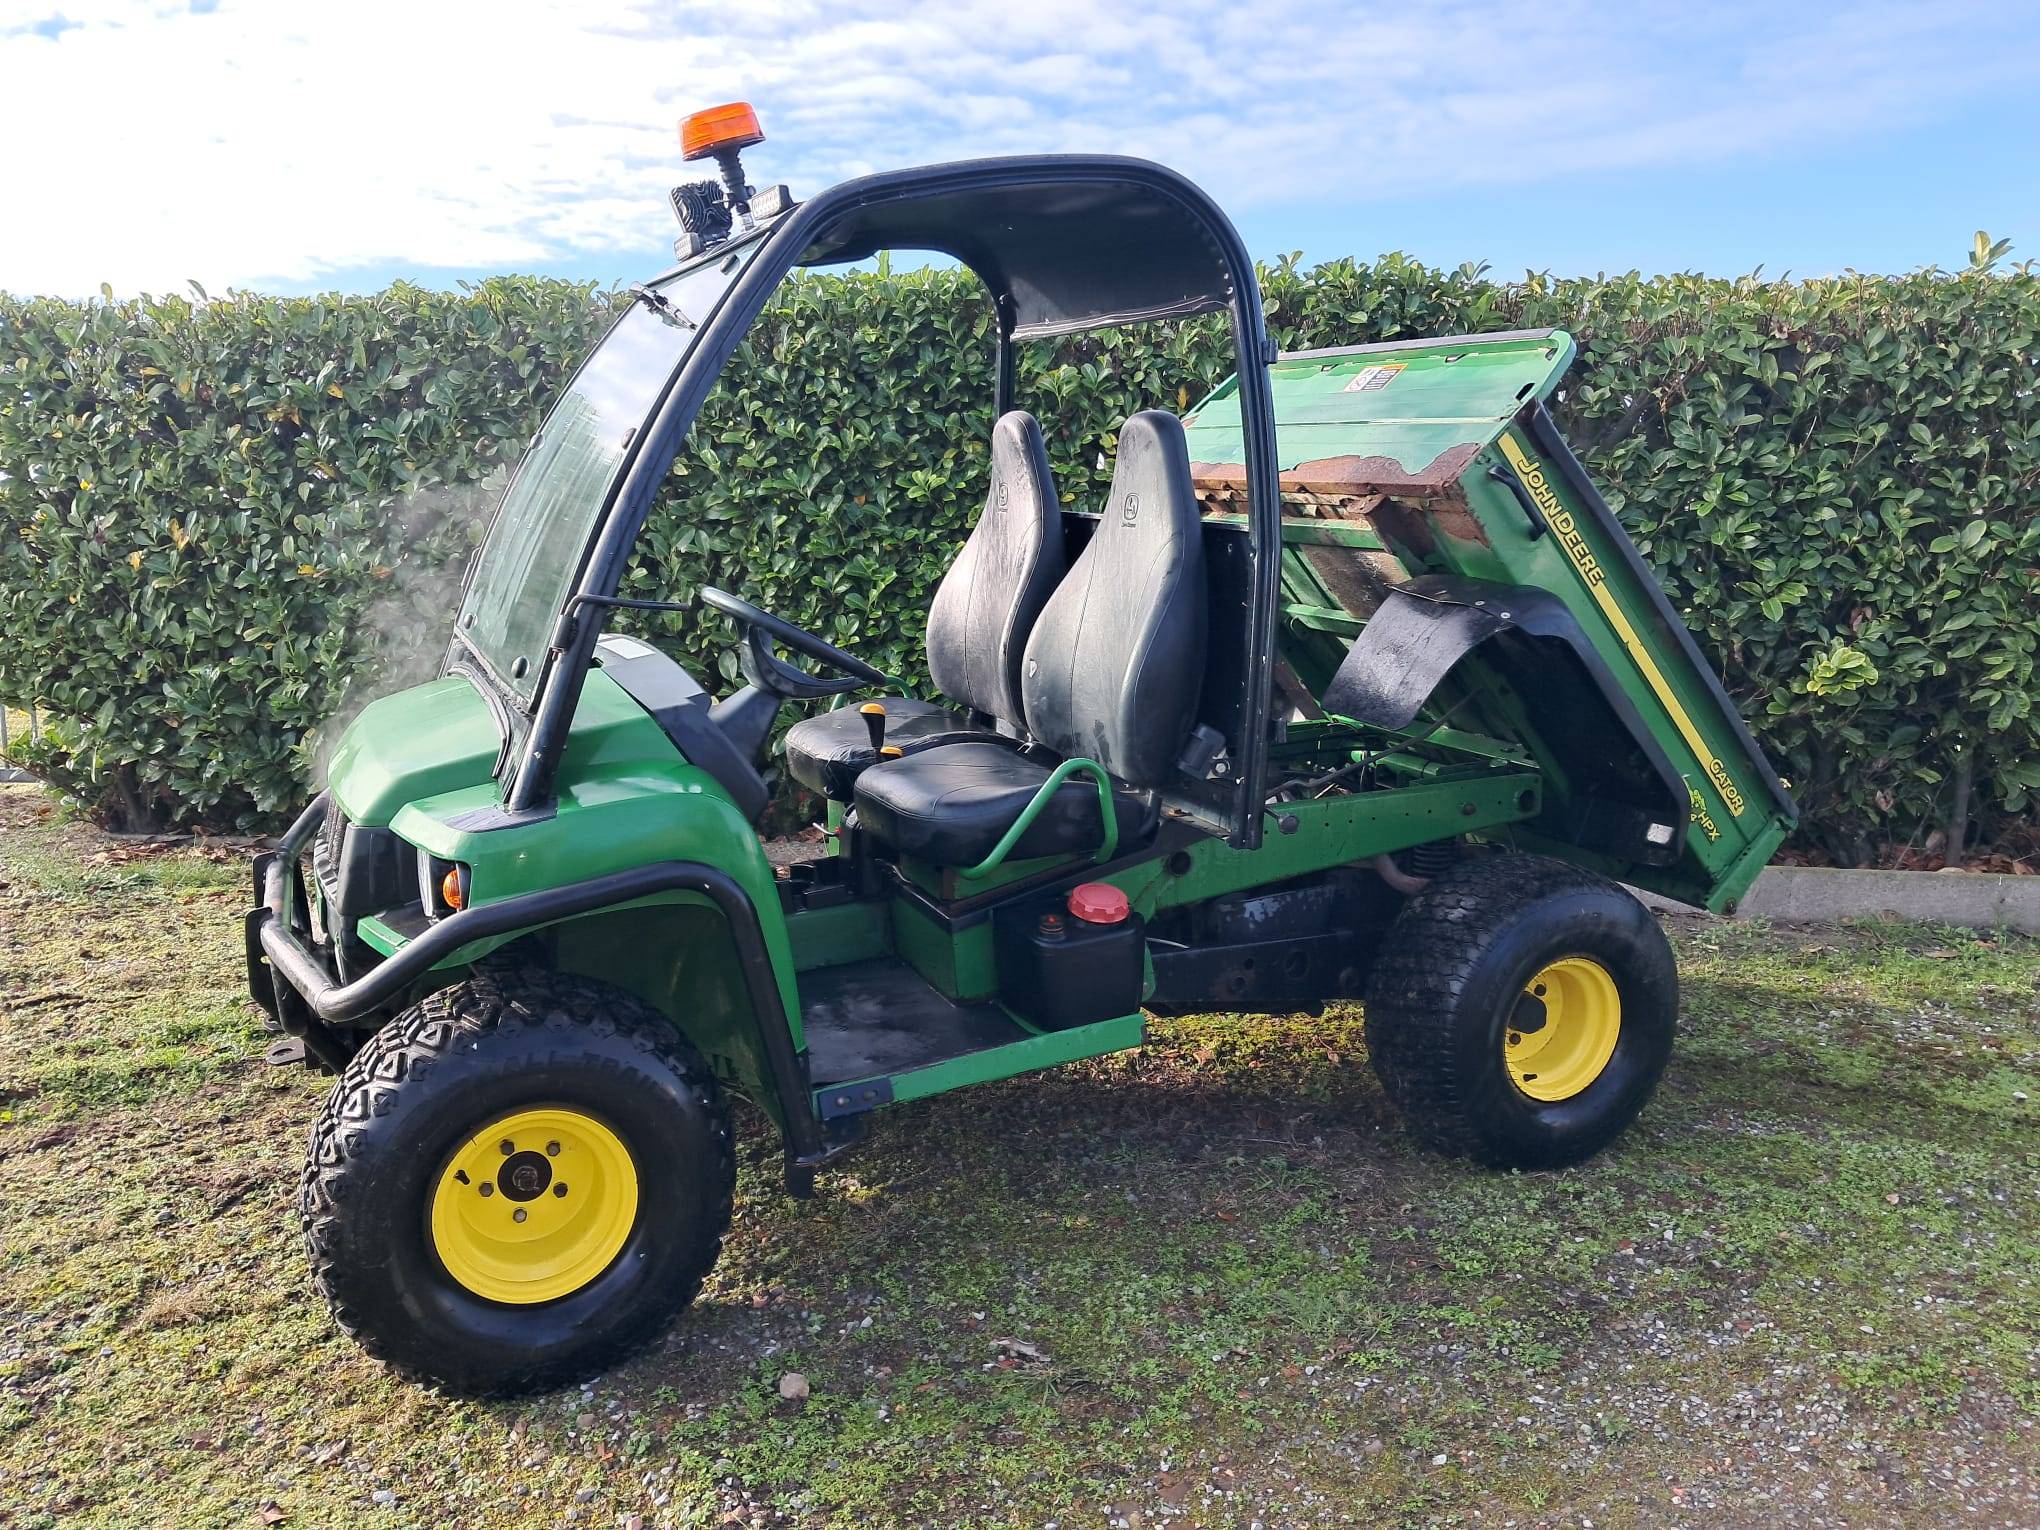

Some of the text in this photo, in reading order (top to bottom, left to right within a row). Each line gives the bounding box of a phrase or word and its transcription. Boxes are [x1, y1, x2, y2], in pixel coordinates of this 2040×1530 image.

[1553, 511, 1605, 587] DEERE
[1710, 758, 1744, 812] GATOR
[1697, 811, 1721, 841] HPX
